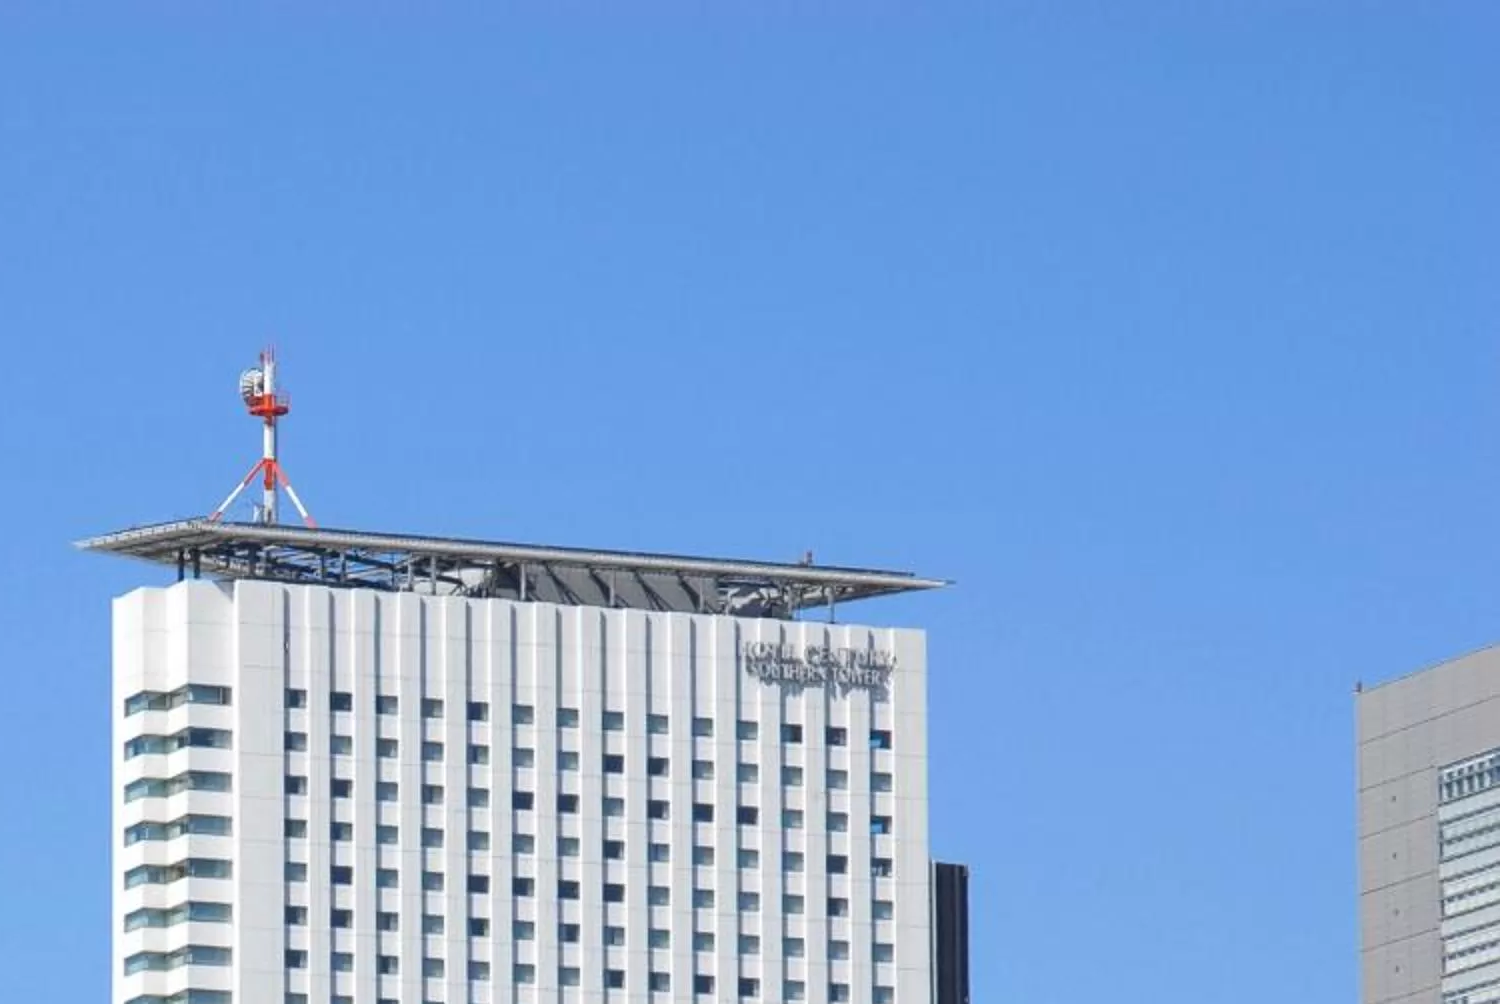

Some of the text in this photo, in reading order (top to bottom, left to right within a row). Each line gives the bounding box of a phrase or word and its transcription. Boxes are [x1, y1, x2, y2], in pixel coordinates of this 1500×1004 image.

[804, 644, 894, 667] CENTURY
[748, 661, 882, 685] SOUTHERN TOWER
